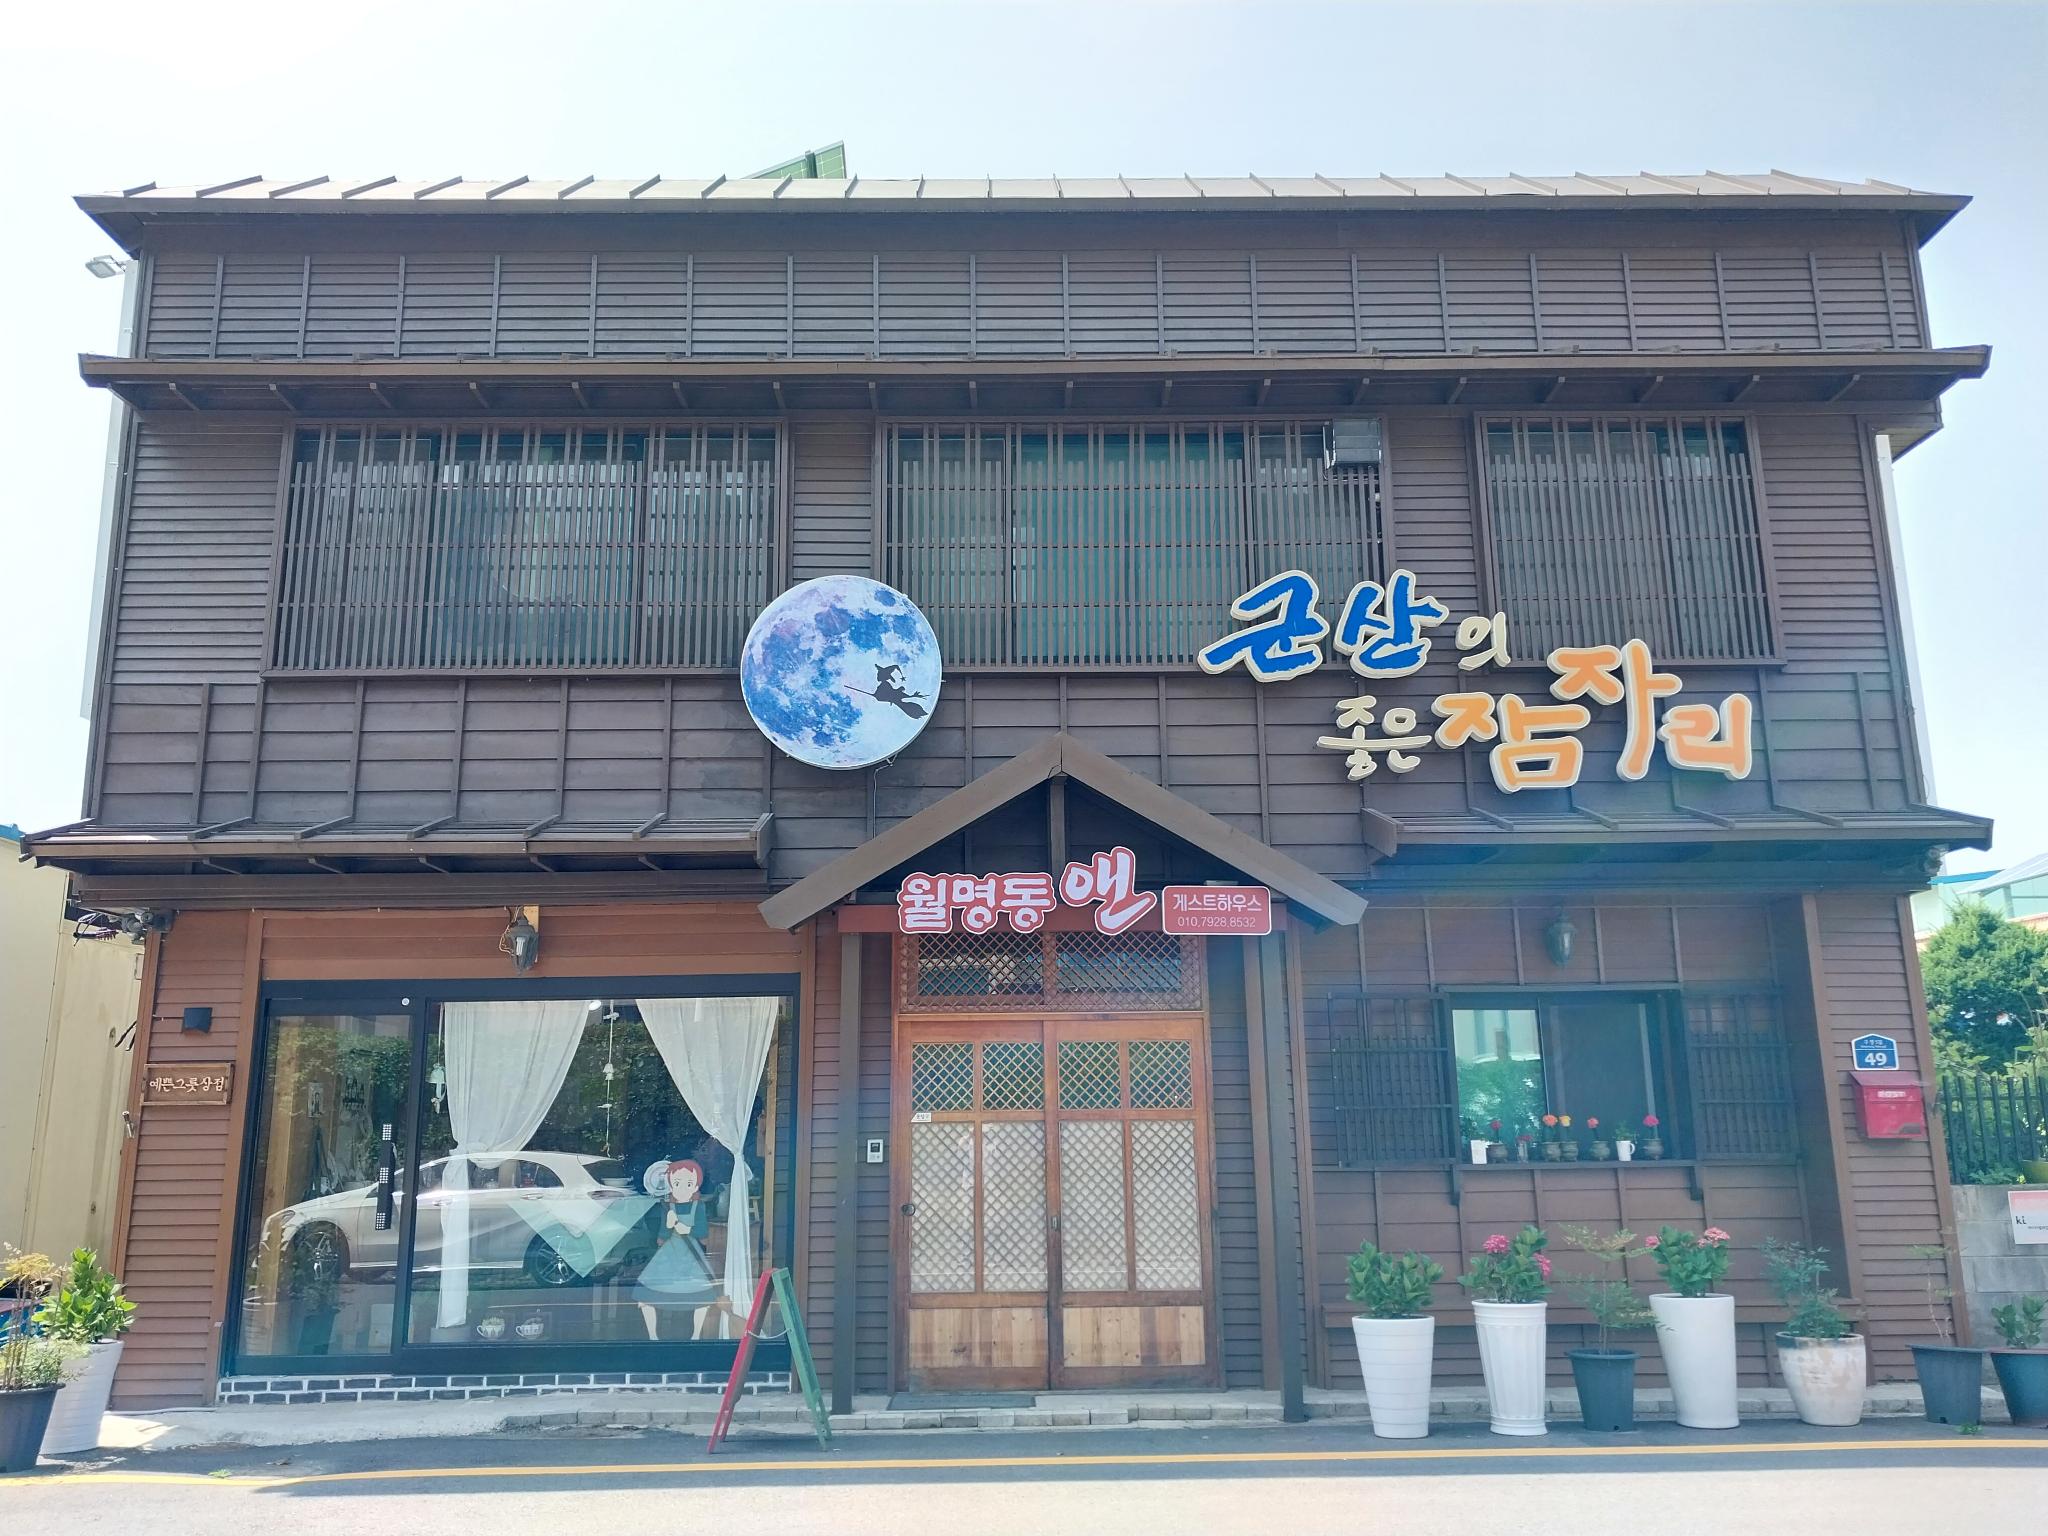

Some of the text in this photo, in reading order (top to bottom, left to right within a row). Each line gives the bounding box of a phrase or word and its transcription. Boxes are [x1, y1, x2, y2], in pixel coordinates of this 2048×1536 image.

[1316, 638, 1752, 794] 좋은 잠자리
[899, 873, 1055, 933] 월명동
[1172, 894, 1263, 912] 게스트하우스
[1864, 1052, 1887, 1066] 49
